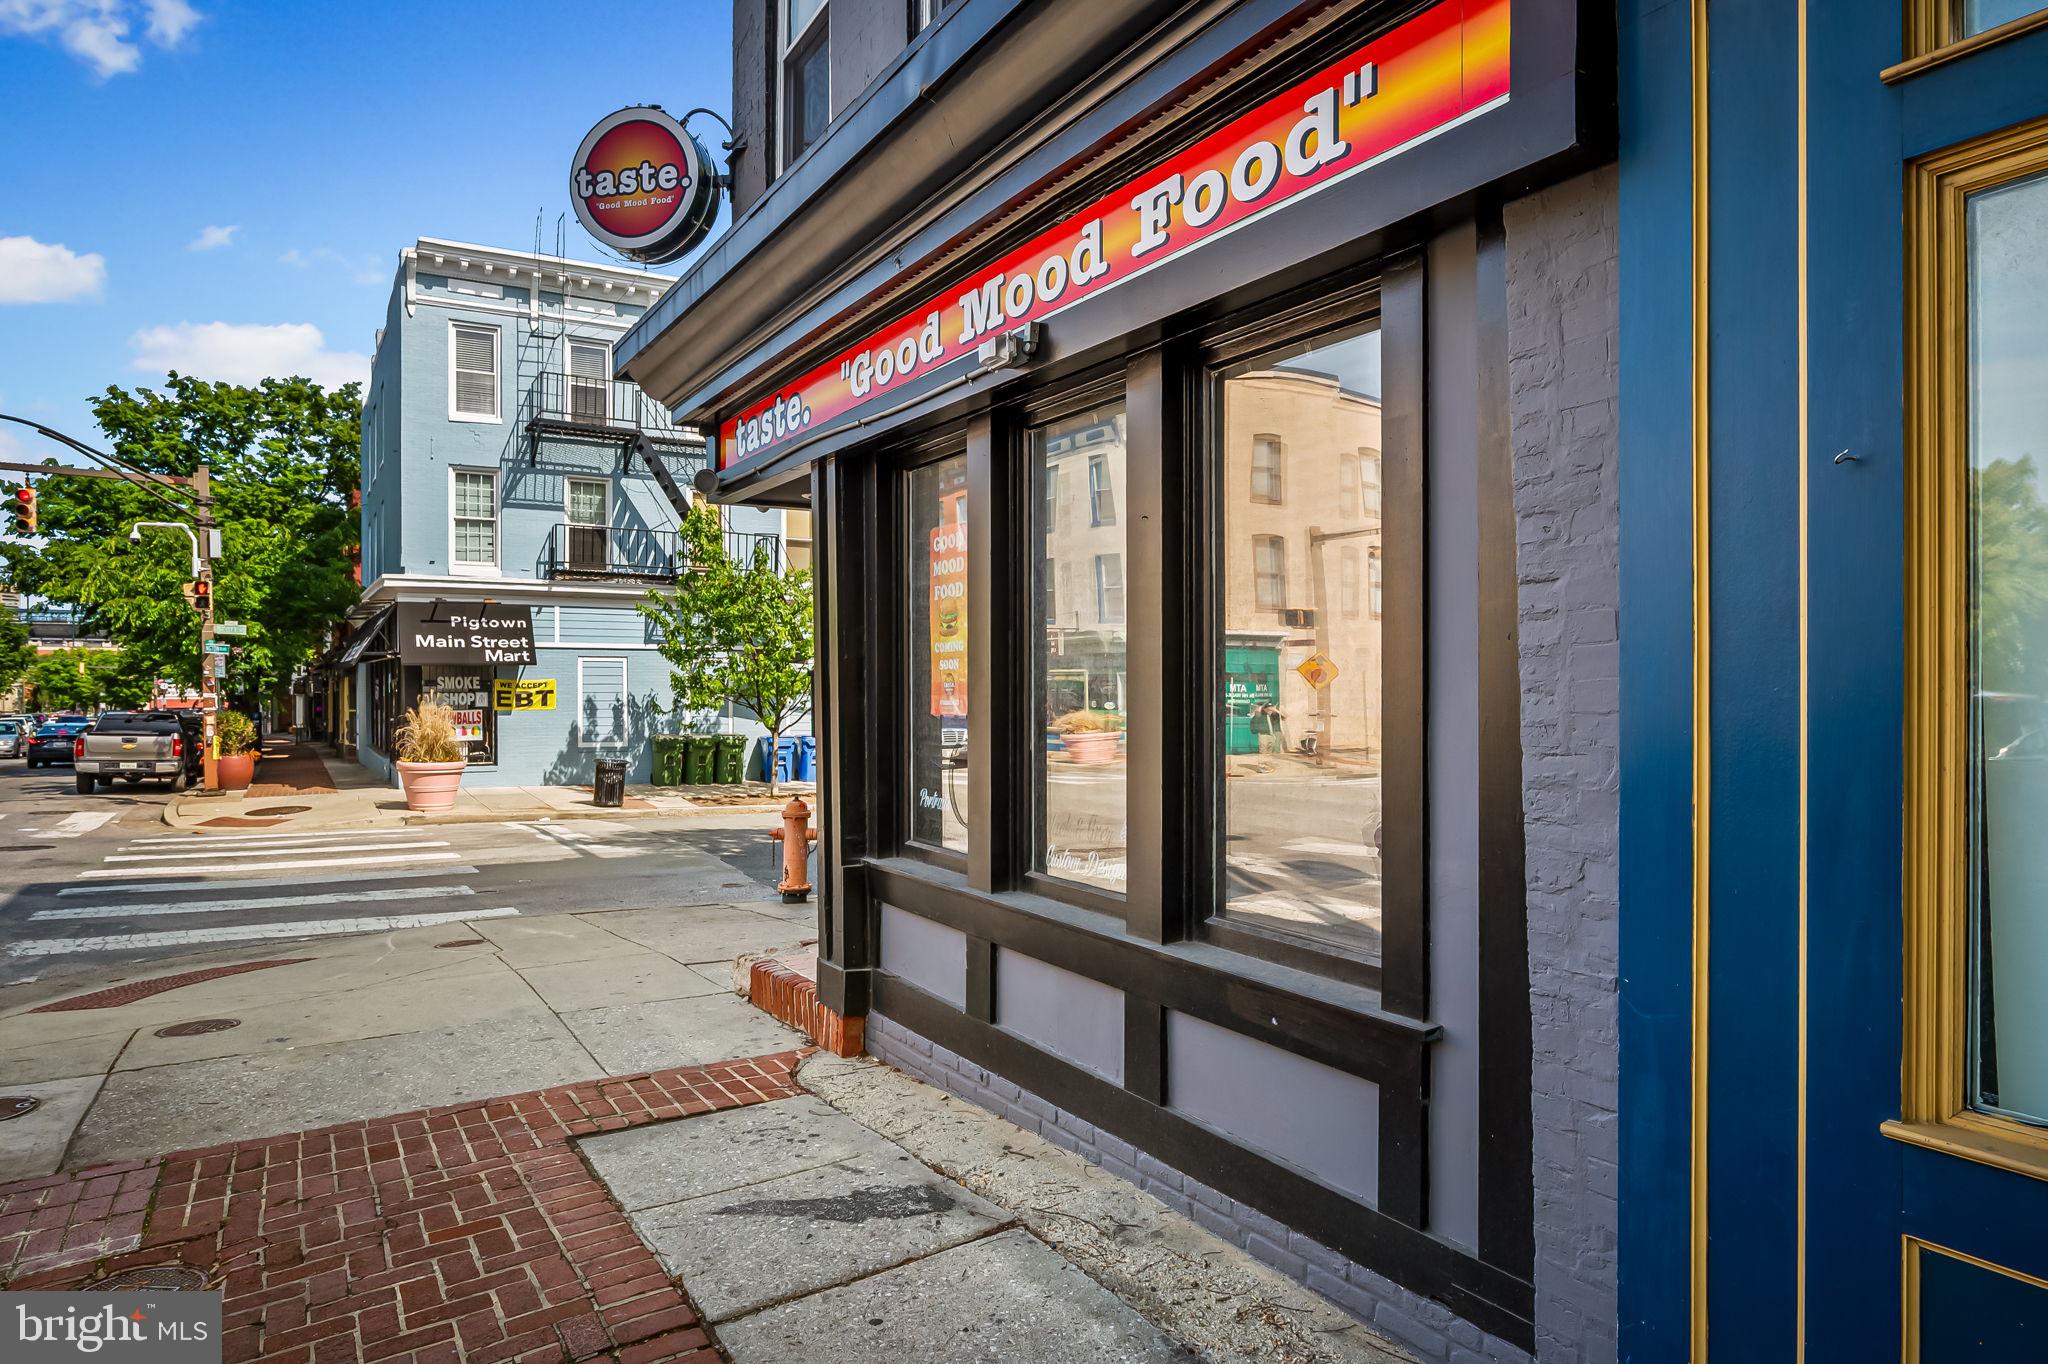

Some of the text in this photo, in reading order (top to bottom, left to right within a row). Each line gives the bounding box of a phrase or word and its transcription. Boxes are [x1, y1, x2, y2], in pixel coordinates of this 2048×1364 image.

[576, 161, 691, 198] taste.
[624, 199, 648, 208] Mood
[735, 62, 1379, 458] taste. "Good Mood Food"
[933, 557, 965, 577] MOOD
[934, 582, 964, 600] FOOD
[451, 616, 527, 630] Pigtown
[415, 634, 529, 648] Main Street
[934, 641, 964, 653] COMING
[485, 650, 531, 662] Mart
[939, 659, 960, 670] SOON
[437, 676, 481, 690] SMOKE
[442, 692, 475, 707] SHOP
[496, 690, 554, 708] EBT
